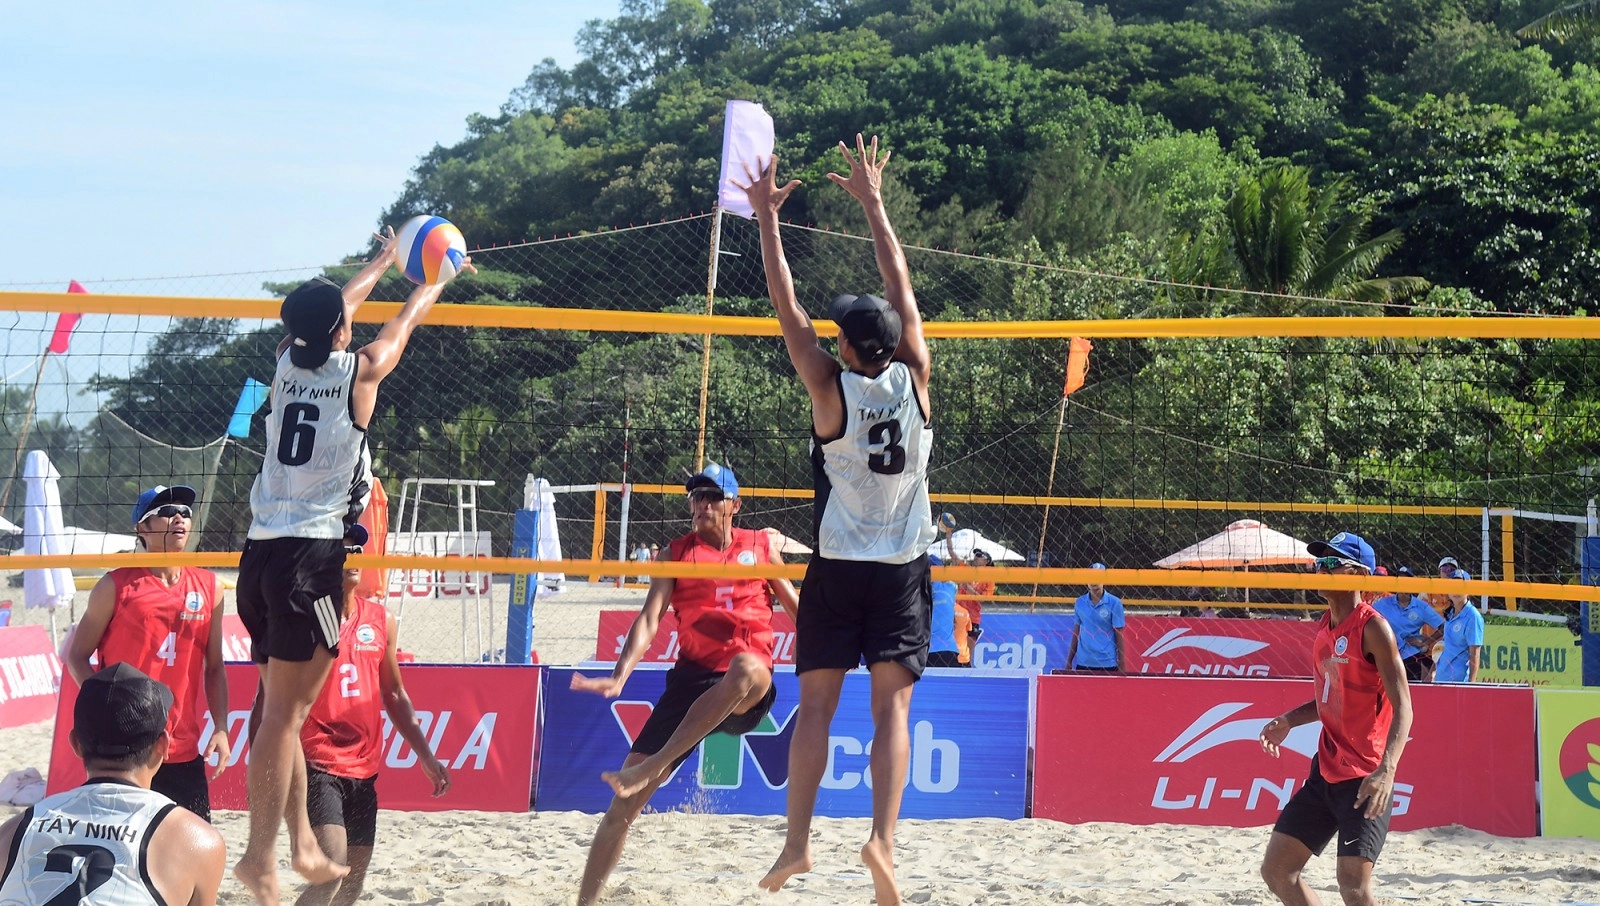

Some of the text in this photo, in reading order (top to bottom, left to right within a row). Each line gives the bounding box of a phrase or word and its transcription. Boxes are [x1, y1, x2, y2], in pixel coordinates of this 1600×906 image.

[282, 379, 307, 398] TÂY
[277, 402, 320, 466] 6
[868, 418, 906, 475] 3
[715, 586, 734, 611] 5
[156, 632, 177, 667] 4
[1497, 641, 1521, 671] CÀ
[1527, 647, 1567, 673] MAU
[339, 663, 361, 698] 2
[197, 710, 498, 770] JOOLA
[1151, 776, 1415, 816] LI-N
[37, 814, 138, 844] TÂY NINH
[42, 844, 116, 906] 2
